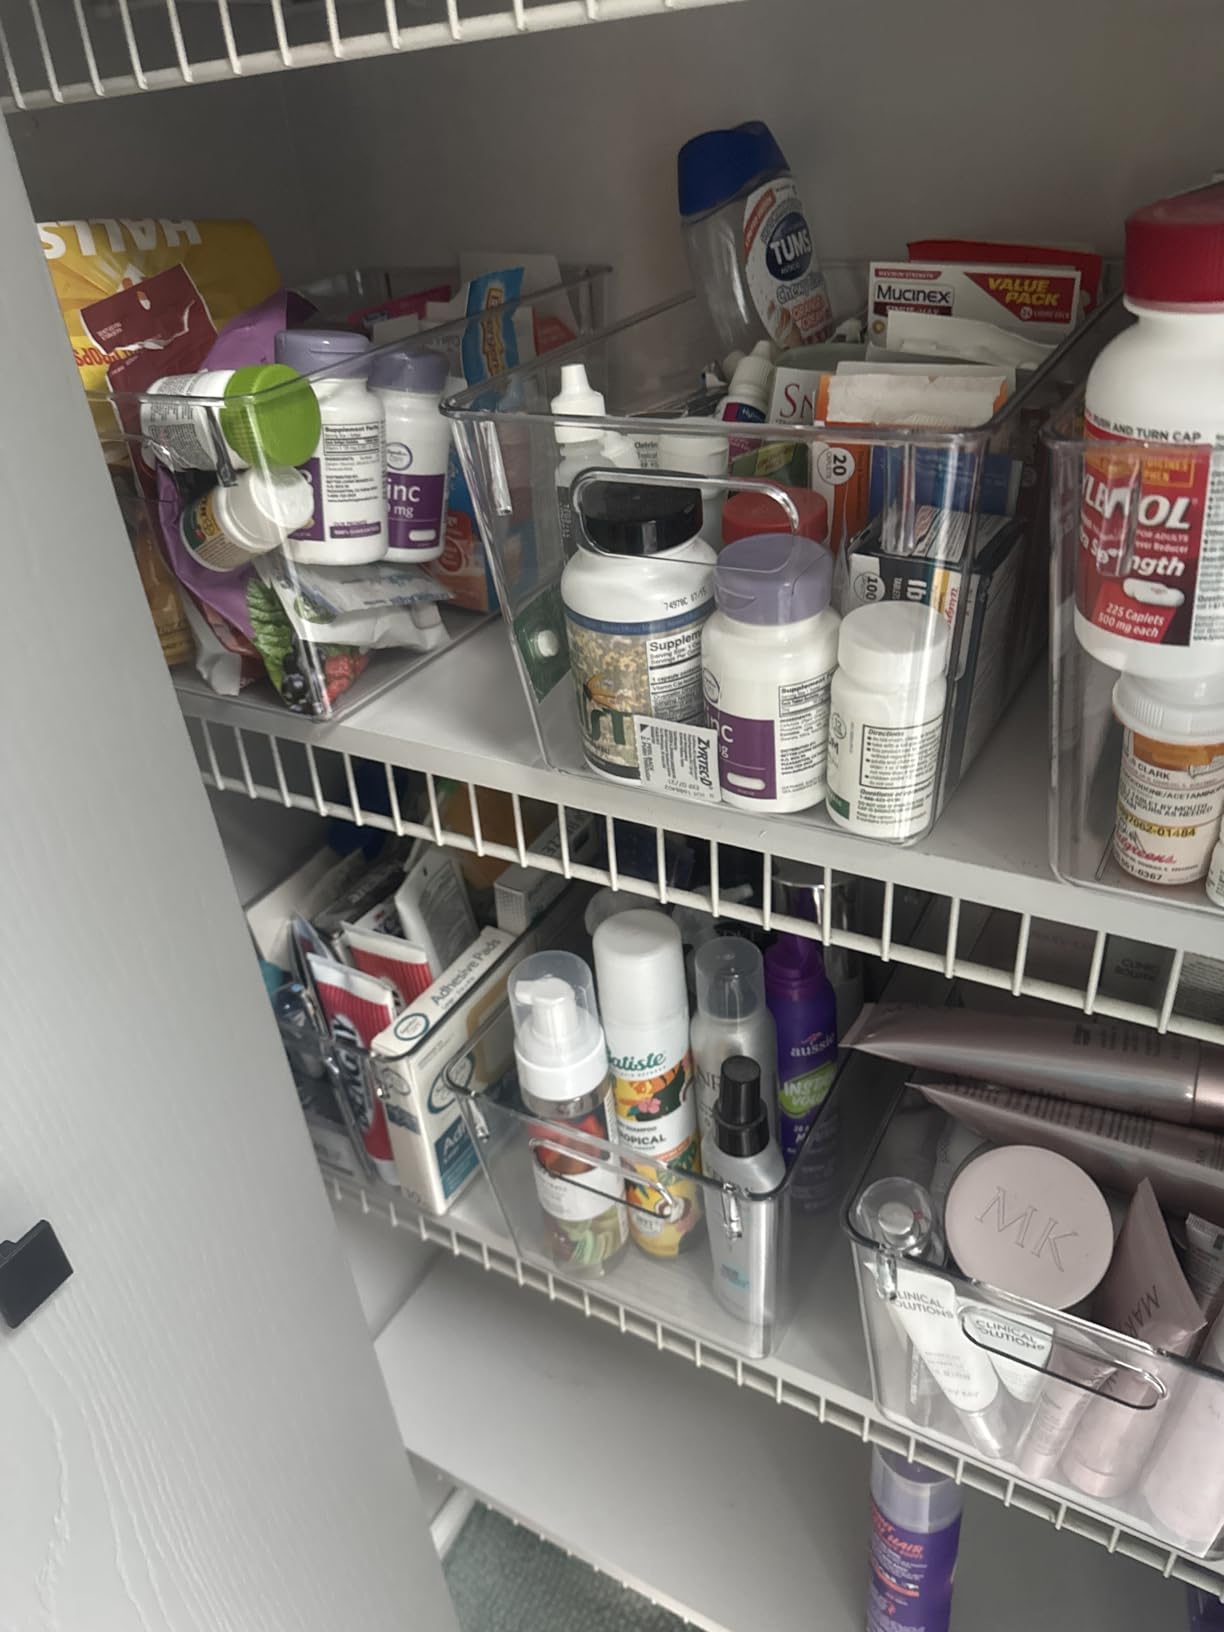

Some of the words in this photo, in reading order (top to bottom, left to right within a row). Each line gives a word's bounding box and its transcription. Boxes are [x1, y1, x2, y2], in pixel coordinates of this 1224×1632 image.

[37, 217, 202, 260] HALLS
[769, 229, 812, 266] TUMS
[876, 284, 951, 303] Mucinex
[988, 277, 1050, 293] VALUE
[1005, 291, 1060, 306] PACK
[1113, 423, 1134, 435] AND
[1136, 427, 1169, 441] TURN
[1172, 430, 1203, 442] CAP
[832, 455, 848, 477] 20
[386, 478, 421, 502] inc
[865, 576, 878, 601] 100
[1098, 612, 1116, 627] 500
[1116, 620, 1133, 634] mg
[1133, 625, 1159, 638] each
[1105, 602, 1125, 618] 225
[1125, 608, 1165, 626] Caplets
[649, 630, 702, 652] Supplem
[431, 960, 480, 1006] Adhesive
[473, 939, 501, 962] Pads
[974, 1185, 1080, 1273] MK
[893, 1290, 944, 1309] LINICAL
[975, 1318, 1038, 1345] CLINICAL
